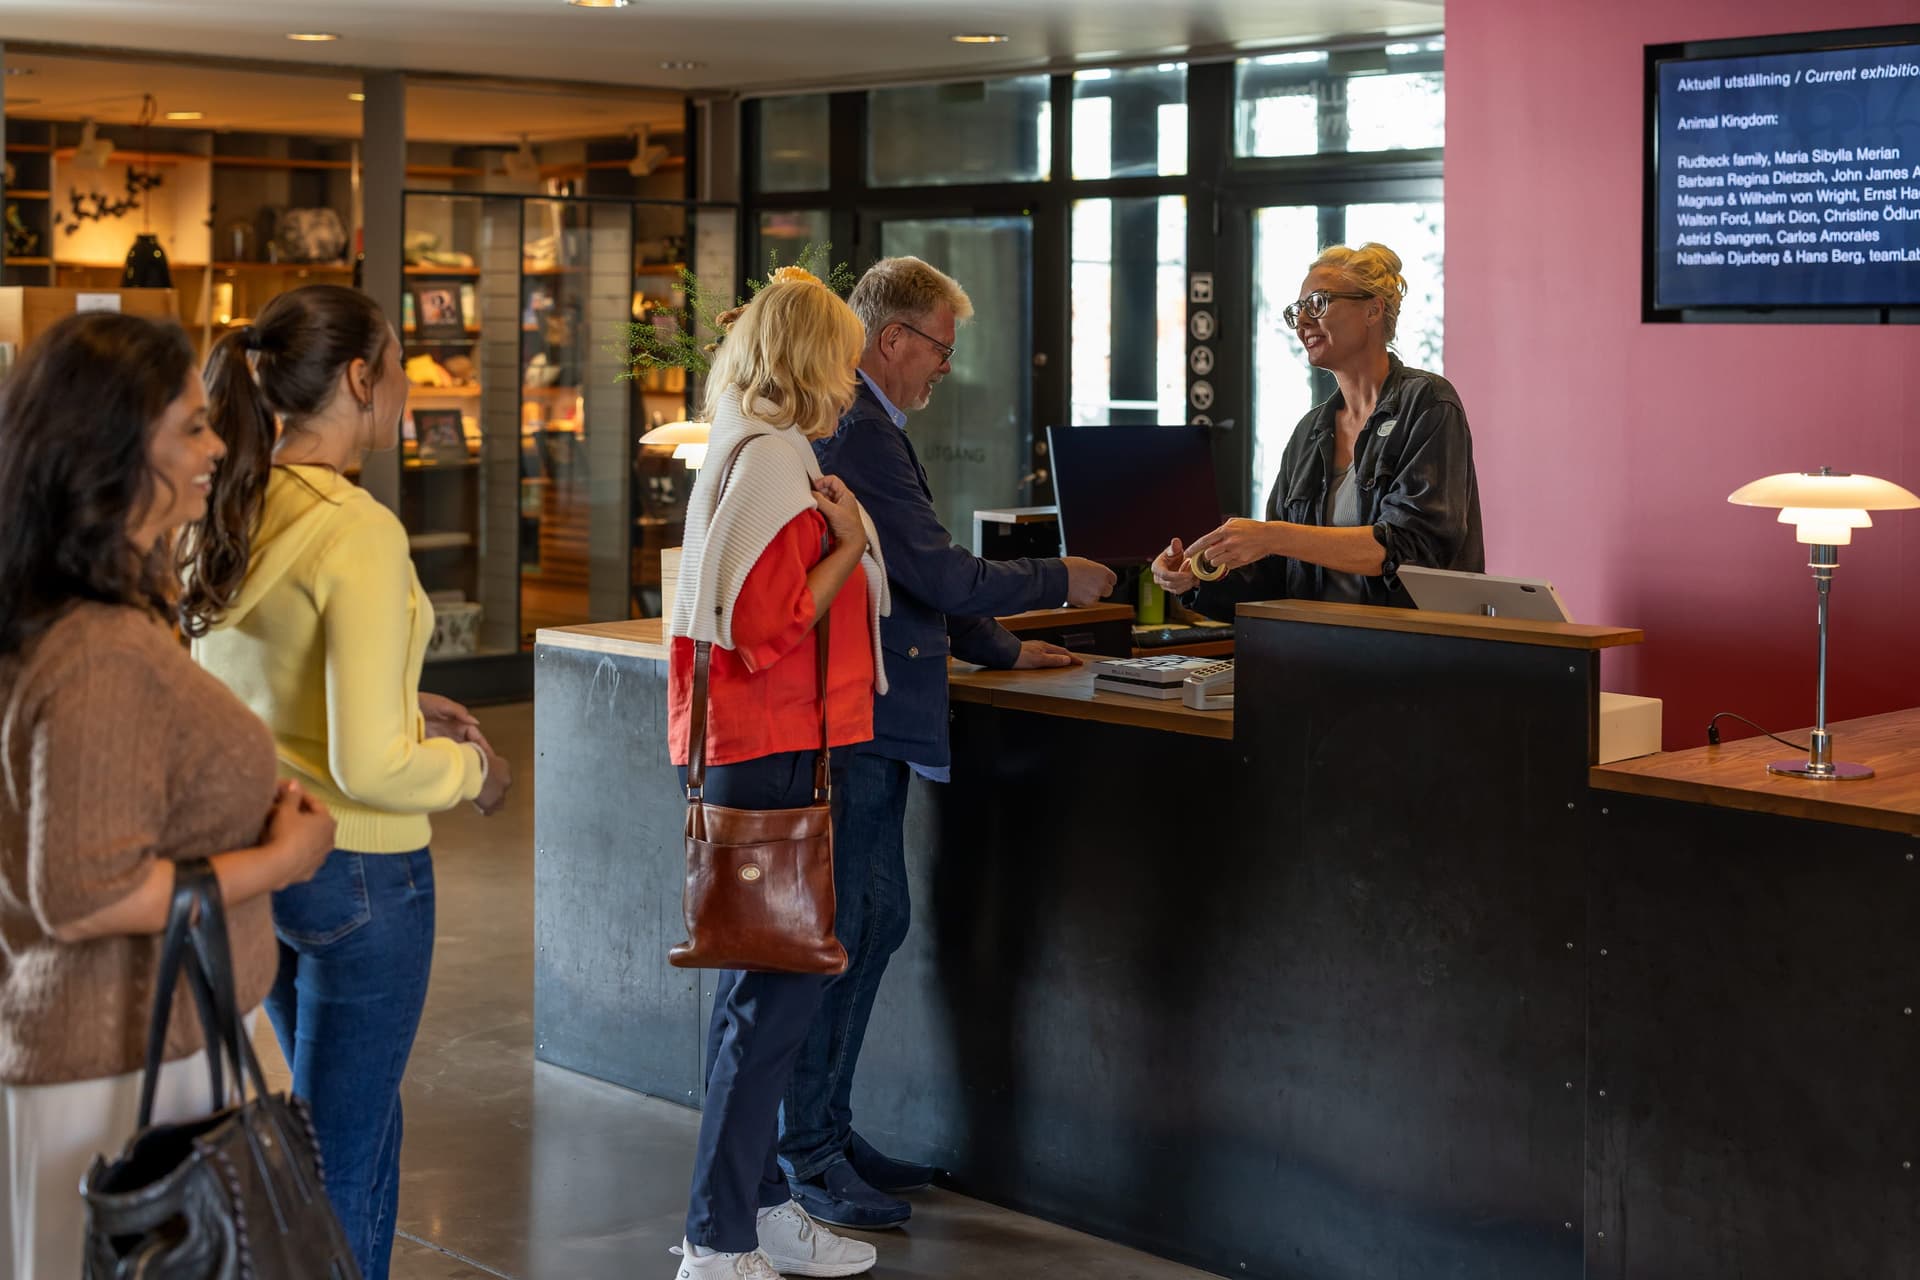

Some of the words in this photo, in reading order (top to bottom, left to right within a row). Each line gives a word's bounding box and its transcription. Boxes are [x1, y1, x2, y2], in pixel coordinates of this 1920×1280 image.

[1677, 76, 1720, 92] Aktuell
[1724, 72, 1790, 88] utställning
[1794, 70, 1801, 84] /
[1805, 67, 1856, 83] Current
[1860, 62, 1920, 80] exhibitio
[1677, 116, 1718, 130] Animal
[1722, 112, 1779, 130] Kingdom:
[1677, 154, 1730, 168] Rudbeck
[1733, 152, 1771, 168] family,
[1774, 150, 1808, 164] Maria
[1812, 148, 1853, 164] Sibylla
[1856, 146, 1900, 160] Merian
[1677, 174, 1724, 188] Barbara
[1727, 172, 1769, 188] Regina
[1773, 170, 1828, 185] Dietzsch,
[1831, 168, 1862, 182] John
[1866, 167, 1908, 181] James
[1677, 194, 1724, 209] Magnus
[1727, 192, 1737, 206] &
[1740, 191, 1787, 205] Wilhelm
[1791, 192, 1813, 204] von
[1816, 188, 1860, 205] Wright,
[1864, 187, 1896, 201] Ernst
[1900, 186, 1920, 200] Ha
[1677, 213, 1717, 226] Walton
[1720, 212, 1751, 226] Ford,
[1754, 211, 1785, 224] Mark
[1789, 210, 1820, 224] Dion,
[1824, 208, 1879, 222] Christine
[1883, 205, 1920, 221] Ödlun
[1677, 232, 1711, 246] Astrid
[1714, 231, 1773, 247] Svangren,
[1777, 230, 1816, 244] Carlos
[1820, 229, 1880, 242] Amorales
[1677, 251, 1725, 265] Nathalie
[1728, 250, 1779, 266] Djurberg
[1783, 250, 1792, 263] &
[1796, 250, 1828, 263] Hans
[1832, 249, 1865, 264] Berg,
